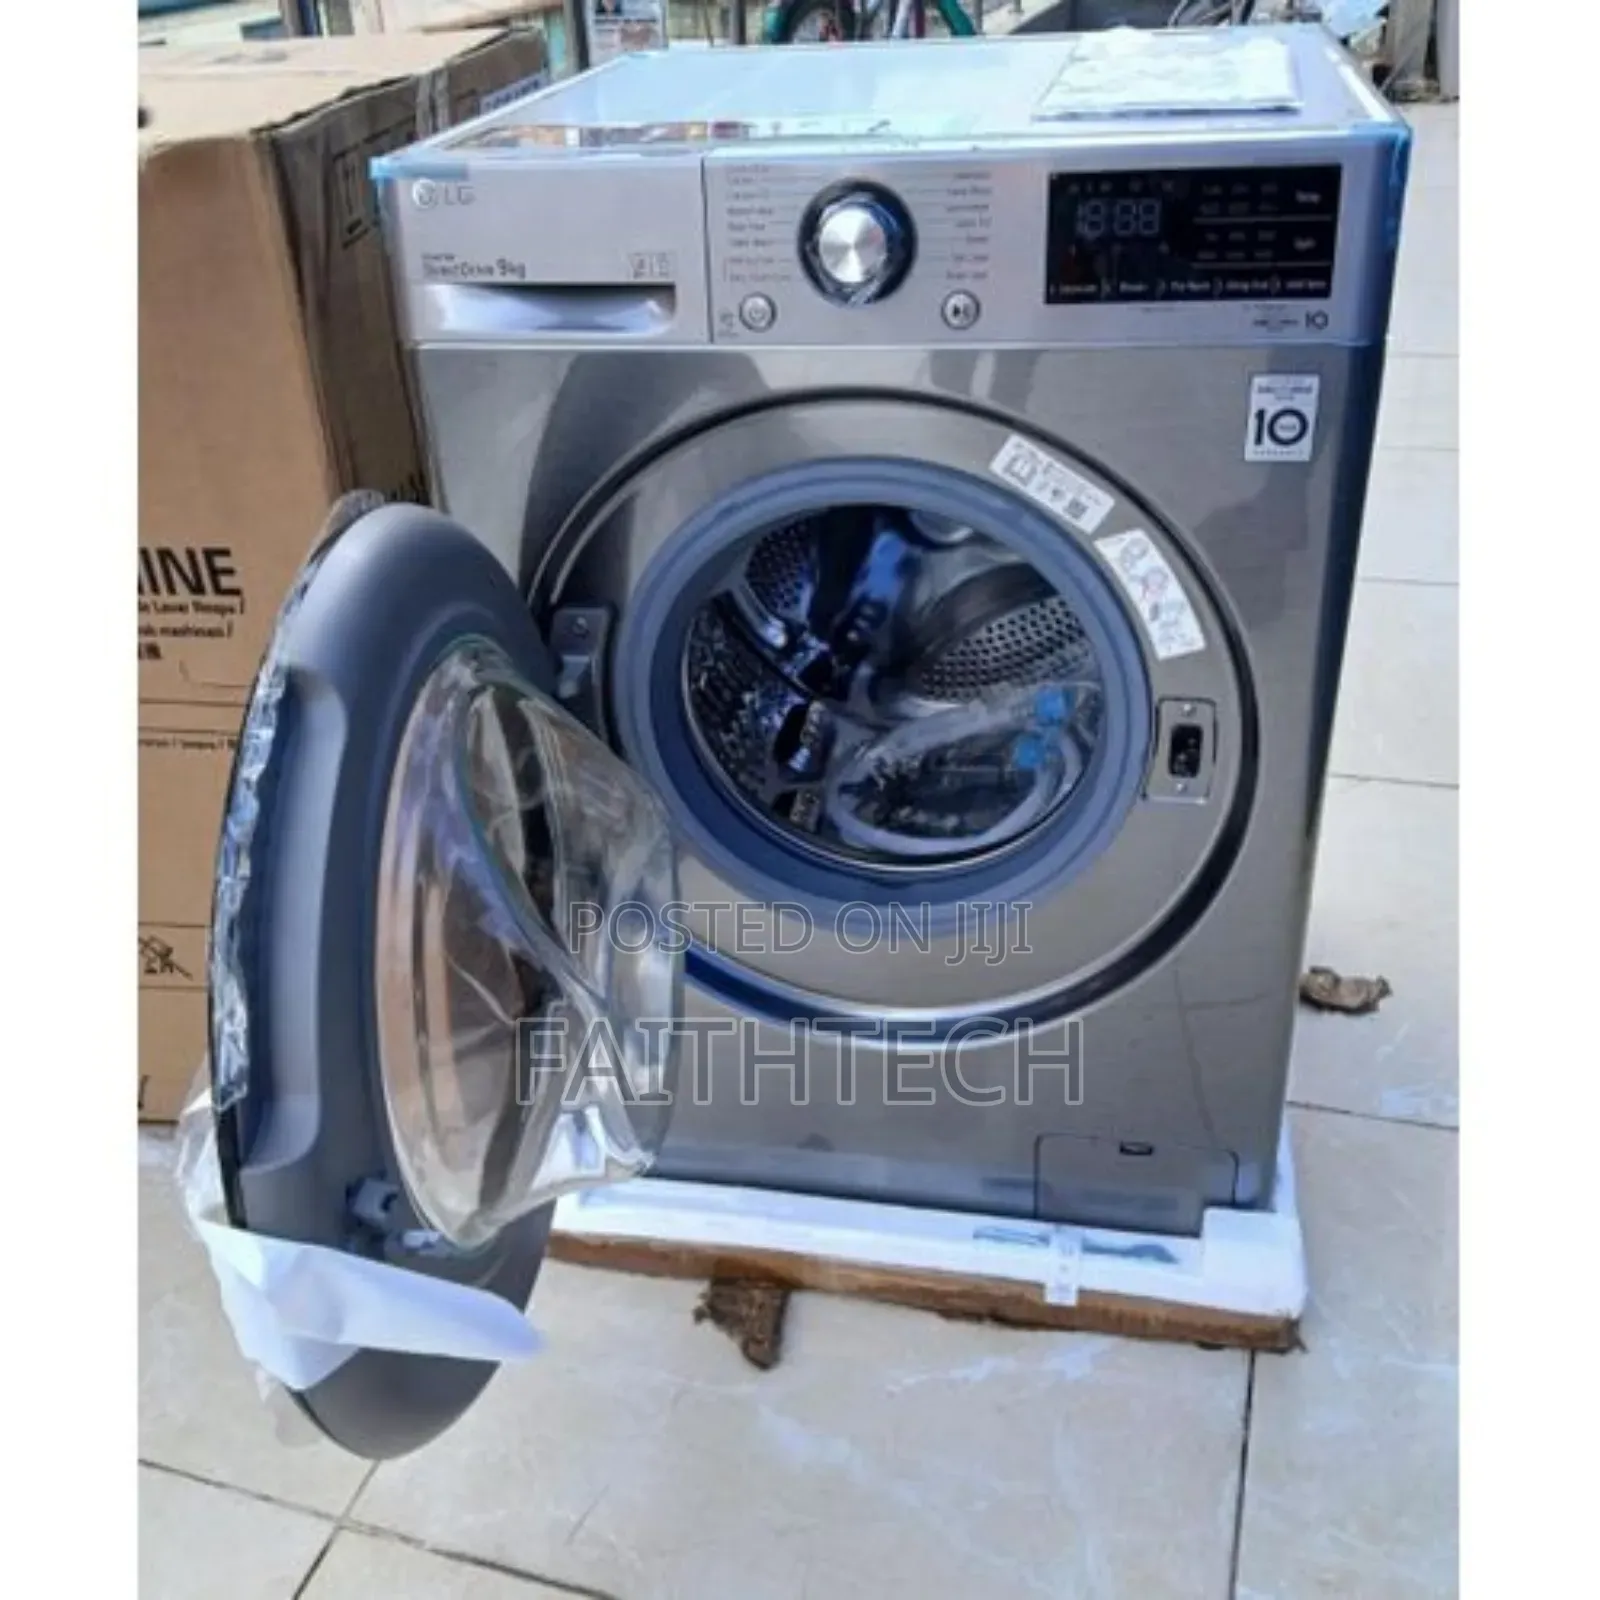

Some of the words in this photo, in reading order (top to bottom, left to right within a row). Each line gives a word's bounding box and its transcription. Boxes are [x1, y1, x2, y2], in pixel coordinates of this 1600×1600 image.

[444, 183, 477, 206] LG
[1253, 406, 1310, 447] 10
[138, 546, 244, 597] INE
